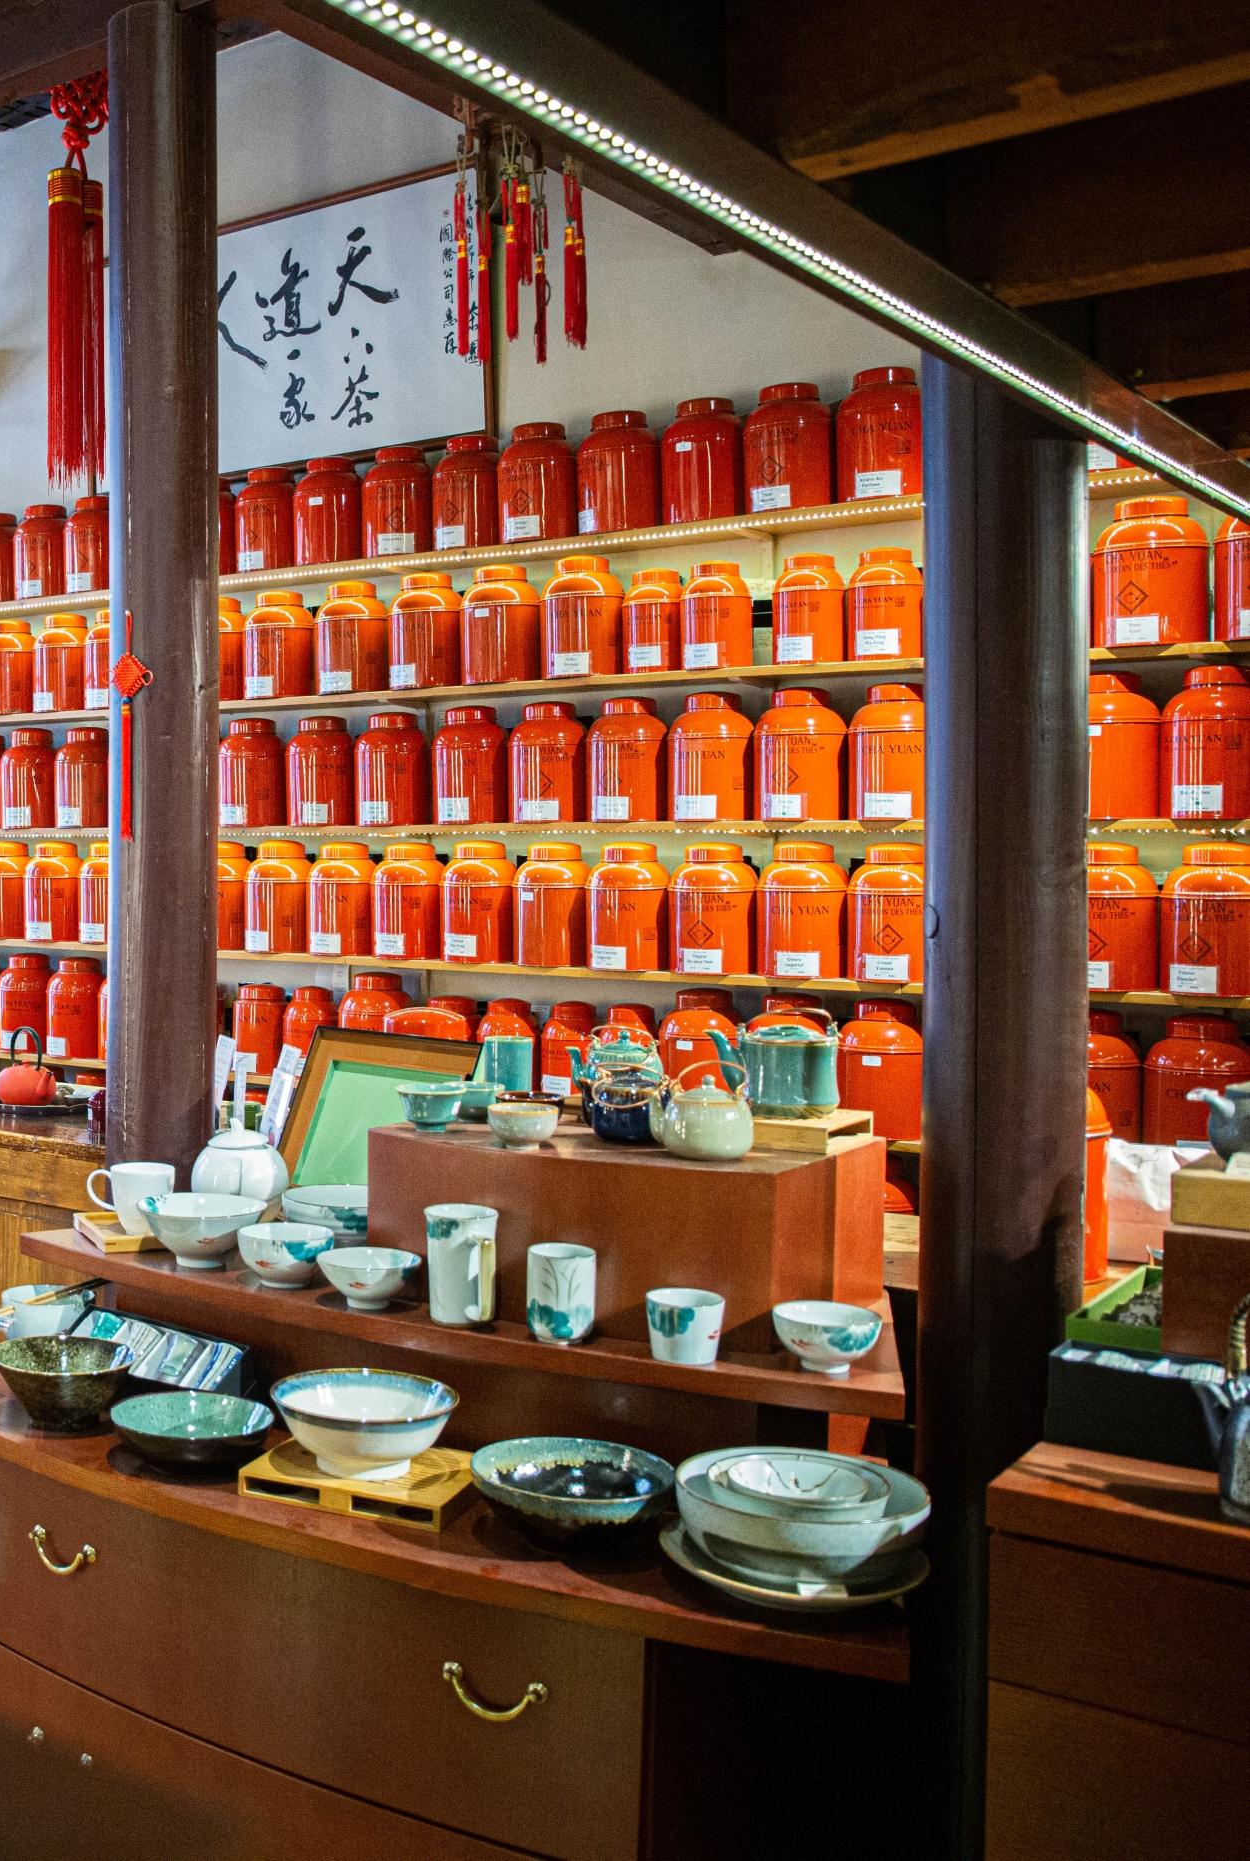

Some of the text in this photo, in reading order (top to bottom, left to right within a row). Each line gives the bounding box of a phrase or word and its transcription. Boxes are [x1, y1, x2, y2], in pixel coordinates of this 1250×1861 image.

[879, 420, 912, 432] YUAN
[1130, 550, 1163, 562] YUAN
[888, 744, 922, 754] YUAN
[887, 898, 915, 908] YUAN
[1089, 900, 1120, 910] YUAN
[771, 905, 830, 915] CHA YUAN
[1093, 911, 1108, 920] DES
